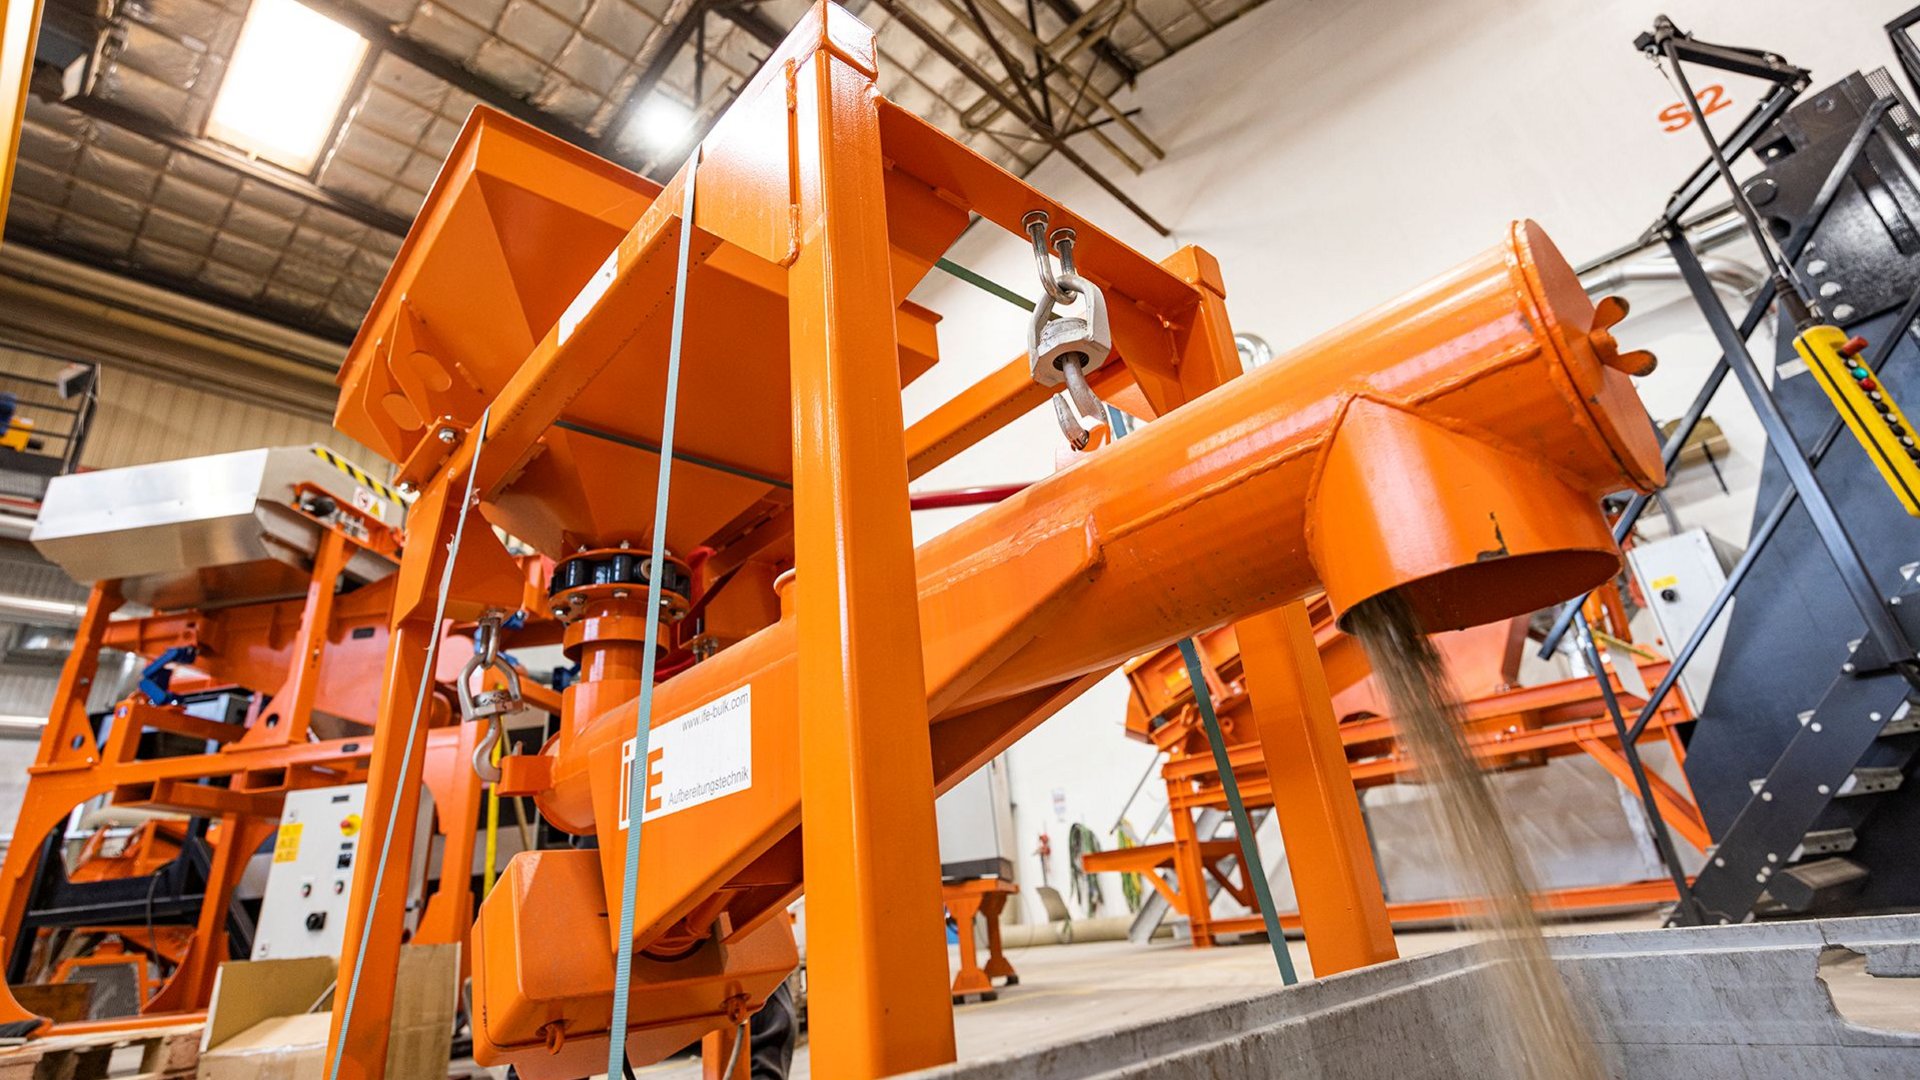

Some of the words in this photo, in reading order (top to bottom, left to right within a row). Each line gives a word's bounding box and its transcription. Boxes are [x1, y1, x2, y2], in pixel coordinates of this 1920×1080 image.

[1658, 84, 1732, 132] S2
[682, 692, 749, 732] www.ife-bulk.com
[621, 744, 664, 823] iE
[668, 766, 749, 806] Aufbereitungstechnik
